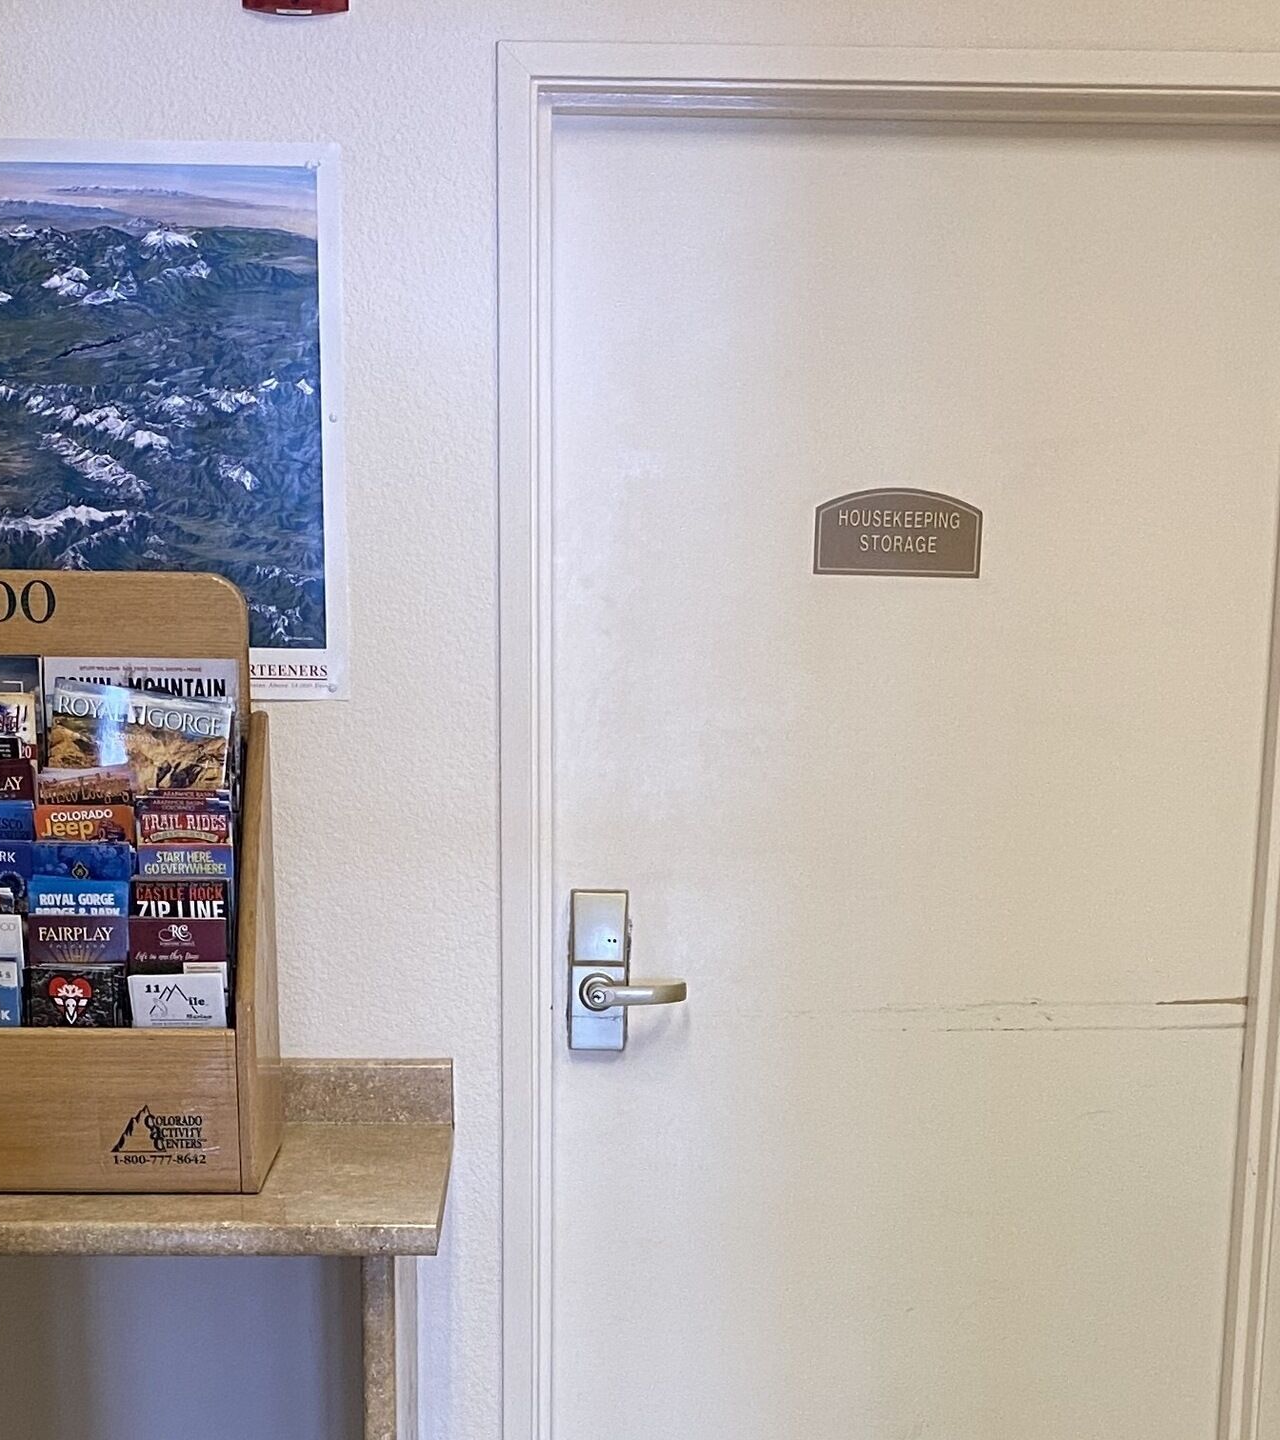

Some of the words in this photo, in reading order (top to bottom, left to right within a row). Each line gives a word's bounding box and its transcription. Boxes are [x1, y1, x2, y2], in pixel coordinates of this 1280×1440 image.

[838, 509, 961, 529] HOUSEKEEPING
[859, 535, 937, 553] STORAGE
[57, 695, 125, 723] ROYAL
[148, 710, 222, 736] GORGE
[51, 808, 113, 822] COLORADO
[40, 818, 94, 840] Jeep
[142, 814, 183, 831] TRAIL
[186, 814, 227, 831] RIDES
[156, 851, 185, 863] START
[144, 863, 159, 874] GO
[160, 863, 226, 875] EVERYWHERE!
[39, 893, 77, 906] ROYAL
[78, 893, 114, 905] GORGE
[136, 886, 185, 900] CASTLE
[189, 886, 224, 900] ROCK
[136, 900, 171, 918] ZIP
[38, 926, 114, 942] FAIRPLAY
[145, 984, 160, 993] 11
[144, 1115, 202, 1128] COLORADO
[153, 1139, 202, 1151] CENTERS
[113, 1154, 207, 1165] 1-800-777-8642
